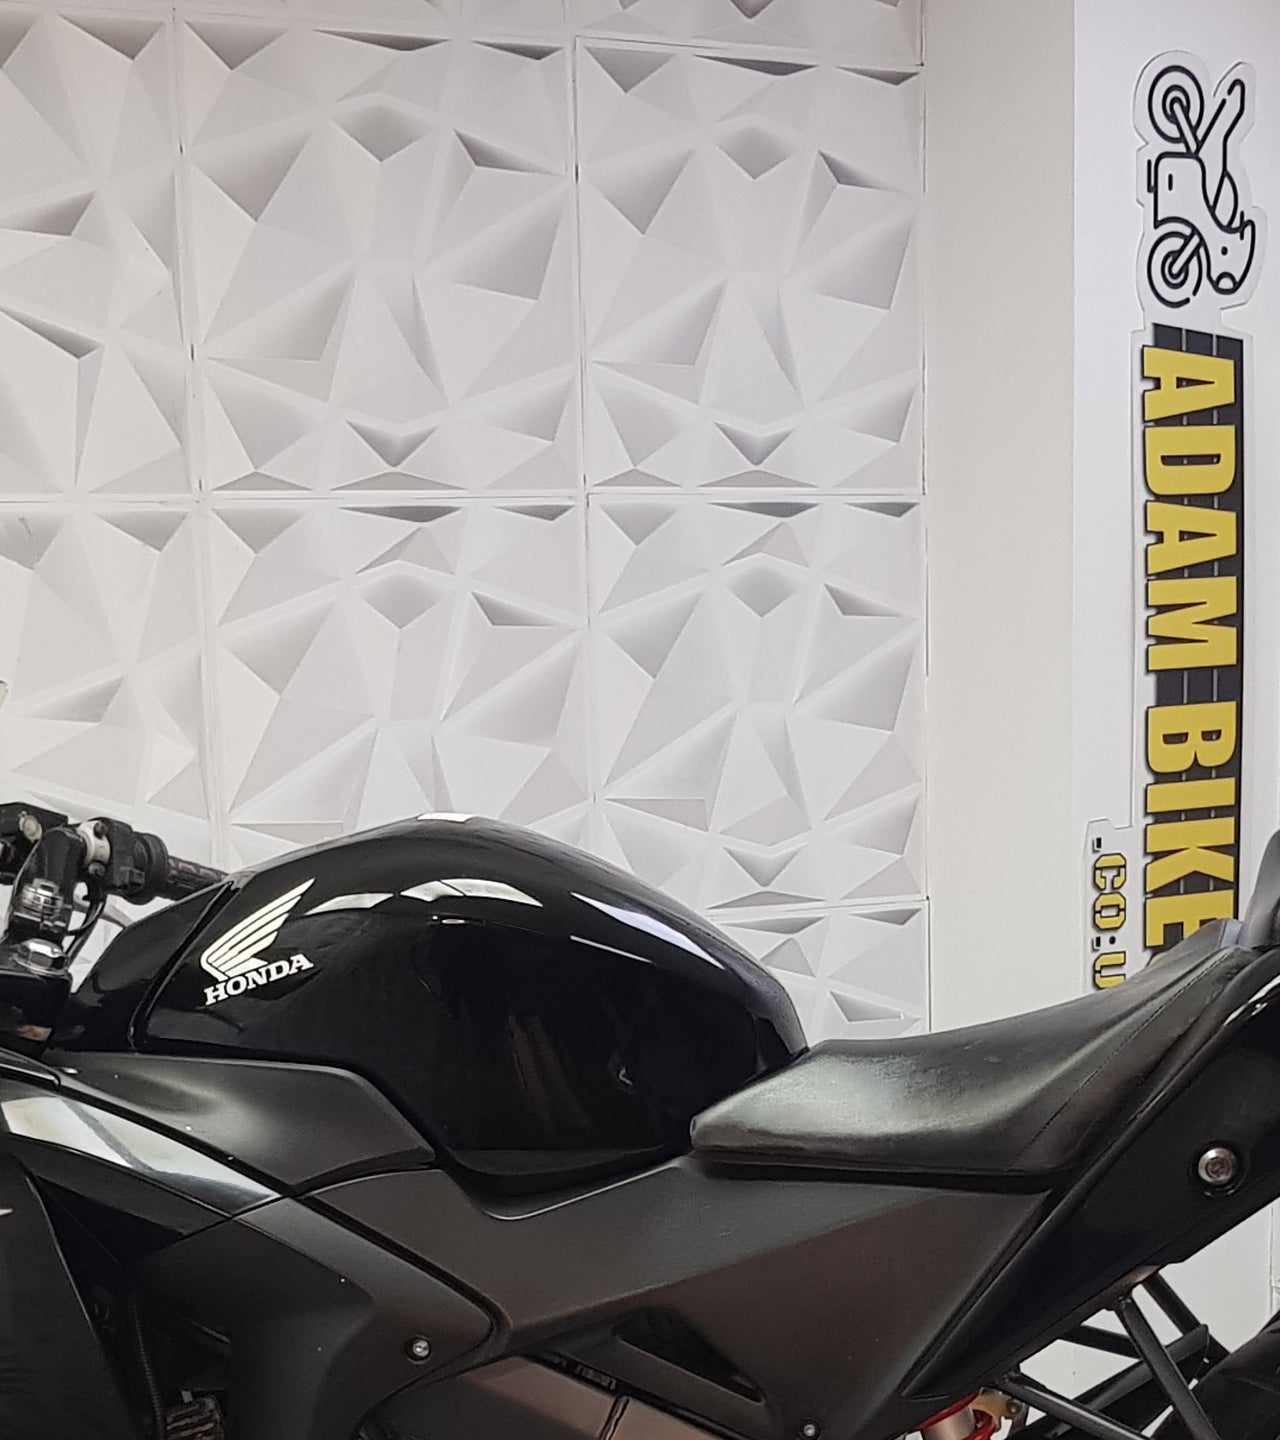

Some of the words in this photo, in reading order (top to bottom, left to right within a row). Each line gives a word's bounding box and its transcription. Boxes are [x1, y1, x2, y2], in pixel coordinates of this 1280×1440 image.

[1143, 345, 1238, 672] ADAM
[1144, 700, 1237, 966] BIKE
[203, 953, 315, 1006] HONDA
